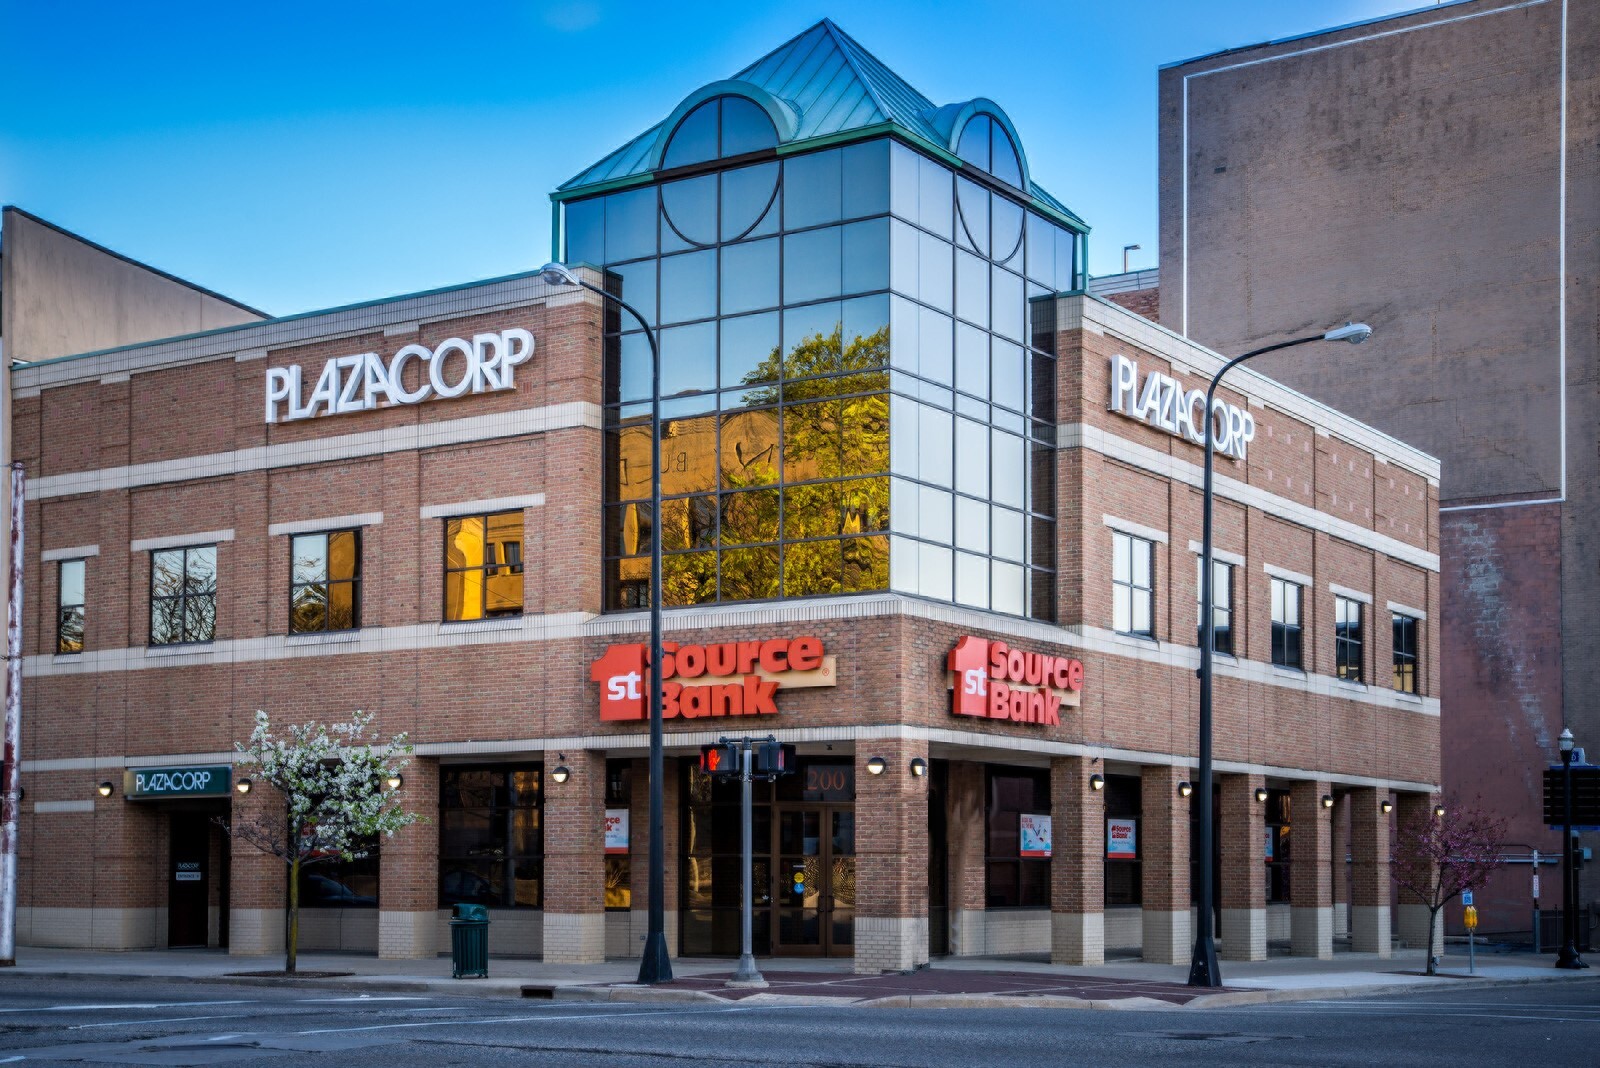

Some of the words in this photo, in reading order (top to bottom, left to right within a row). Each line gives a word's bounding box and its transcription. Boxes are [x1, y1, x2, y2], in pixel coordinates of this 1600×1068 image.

[265, 327, 535, 423] PLAZACORP
[1111, 354, 1255, 460] PLAZACORP
[989, 641, 1085, 691] Source
[647, 675, 780, 719] Bank
[988, 682, 1062, 726] Bank
[136, 772, 211, 791] PLAZACORP
[807, 769, 846, 790] 200
